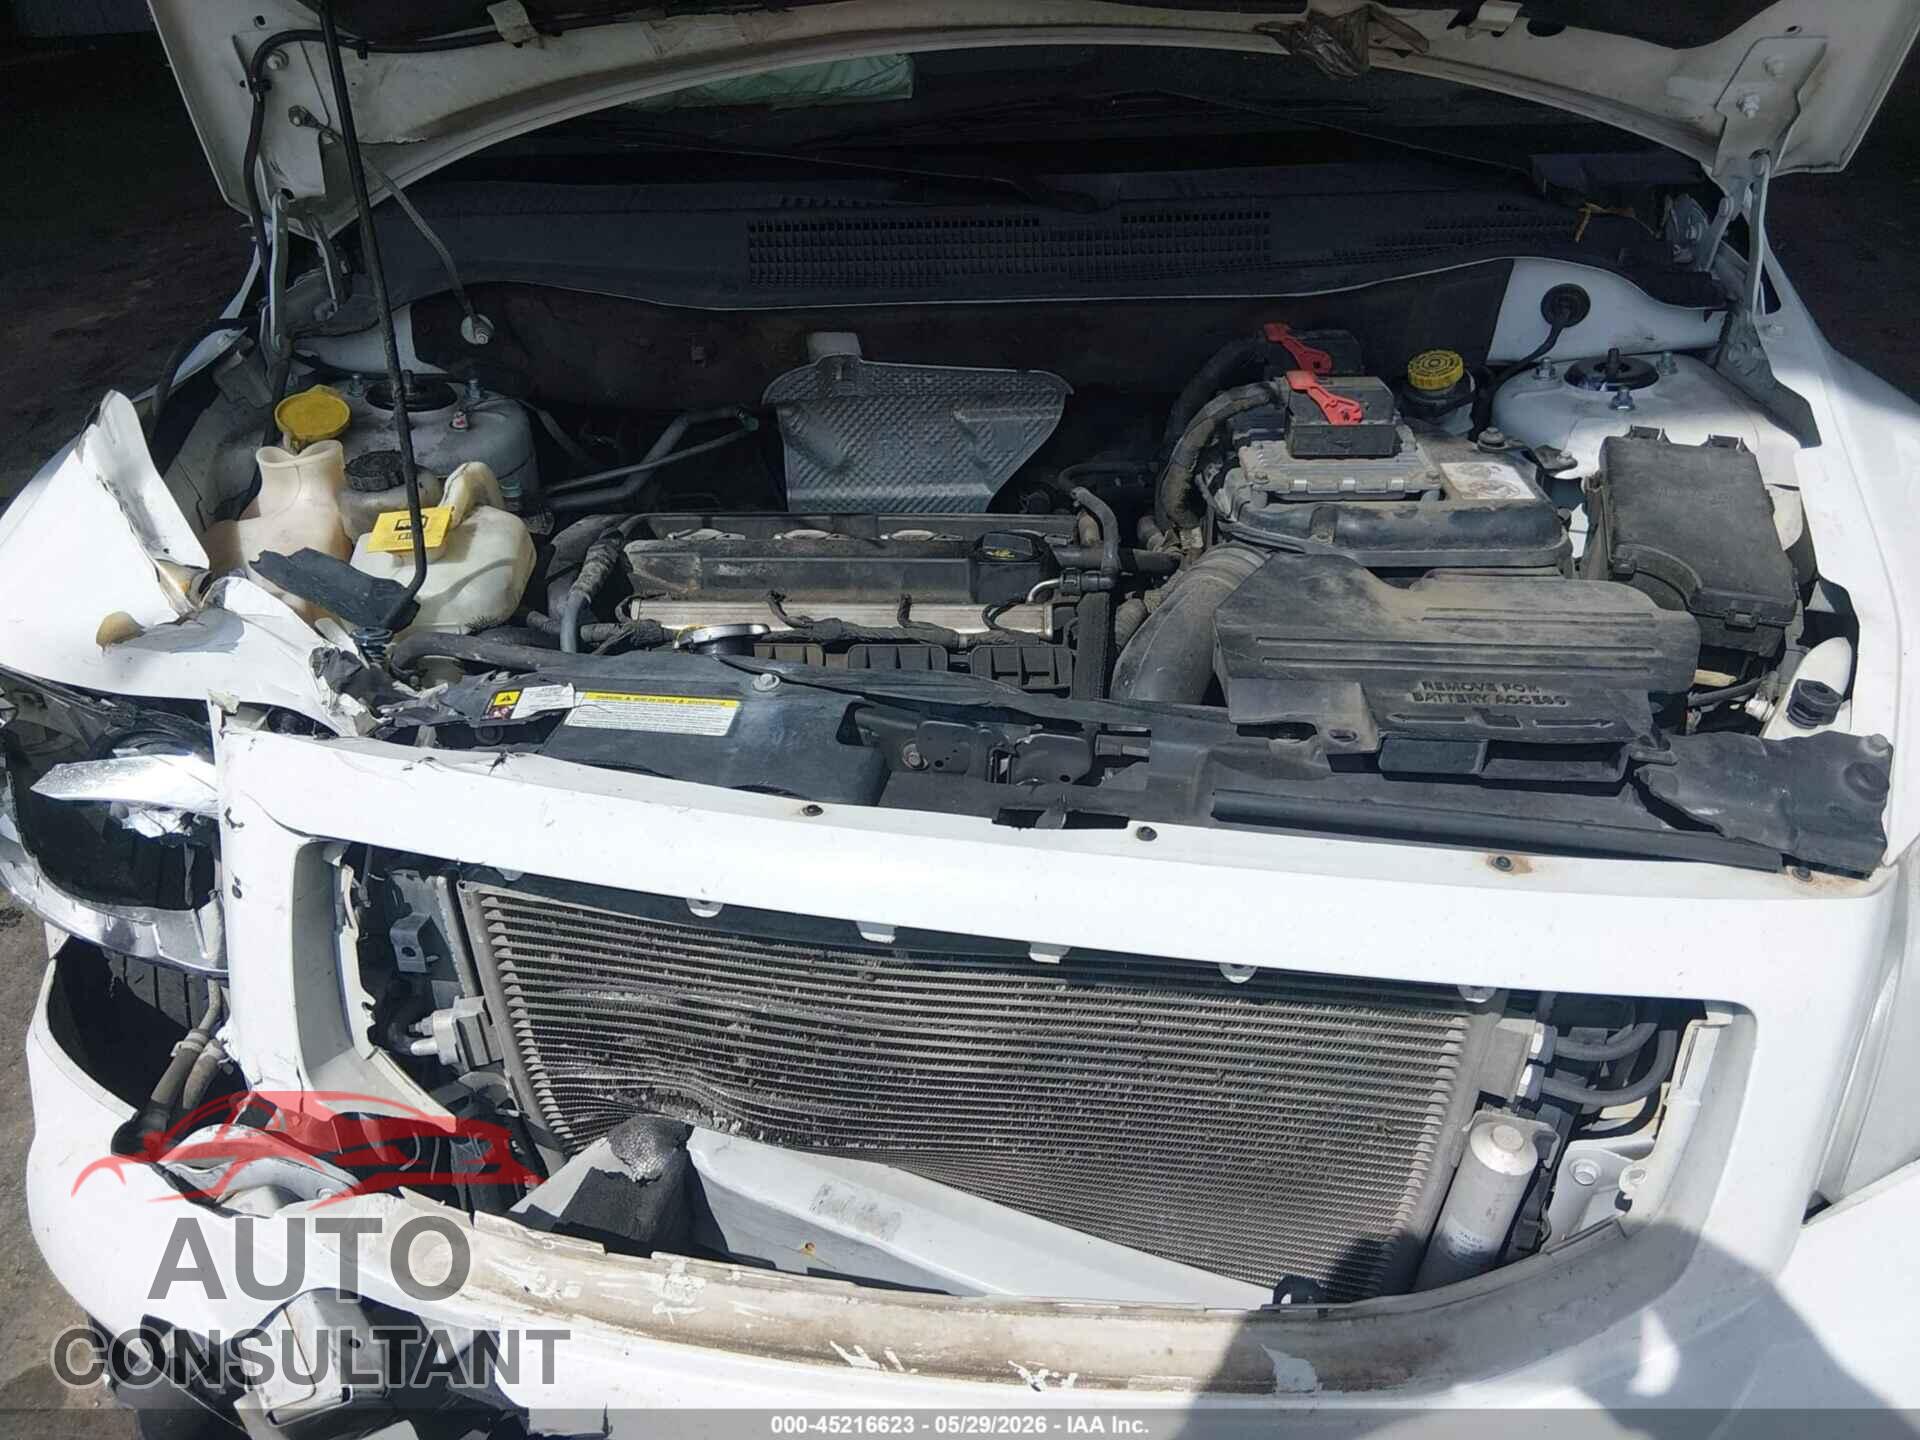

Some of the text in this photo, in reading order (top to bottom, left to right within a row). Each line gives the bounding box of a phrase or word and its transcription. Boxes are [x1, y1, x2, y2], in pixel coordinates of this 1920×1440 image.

[1418, 681, 1497, 692] REMOVE
[1410, 691, 1568, 705] BATTERY ACCESS
